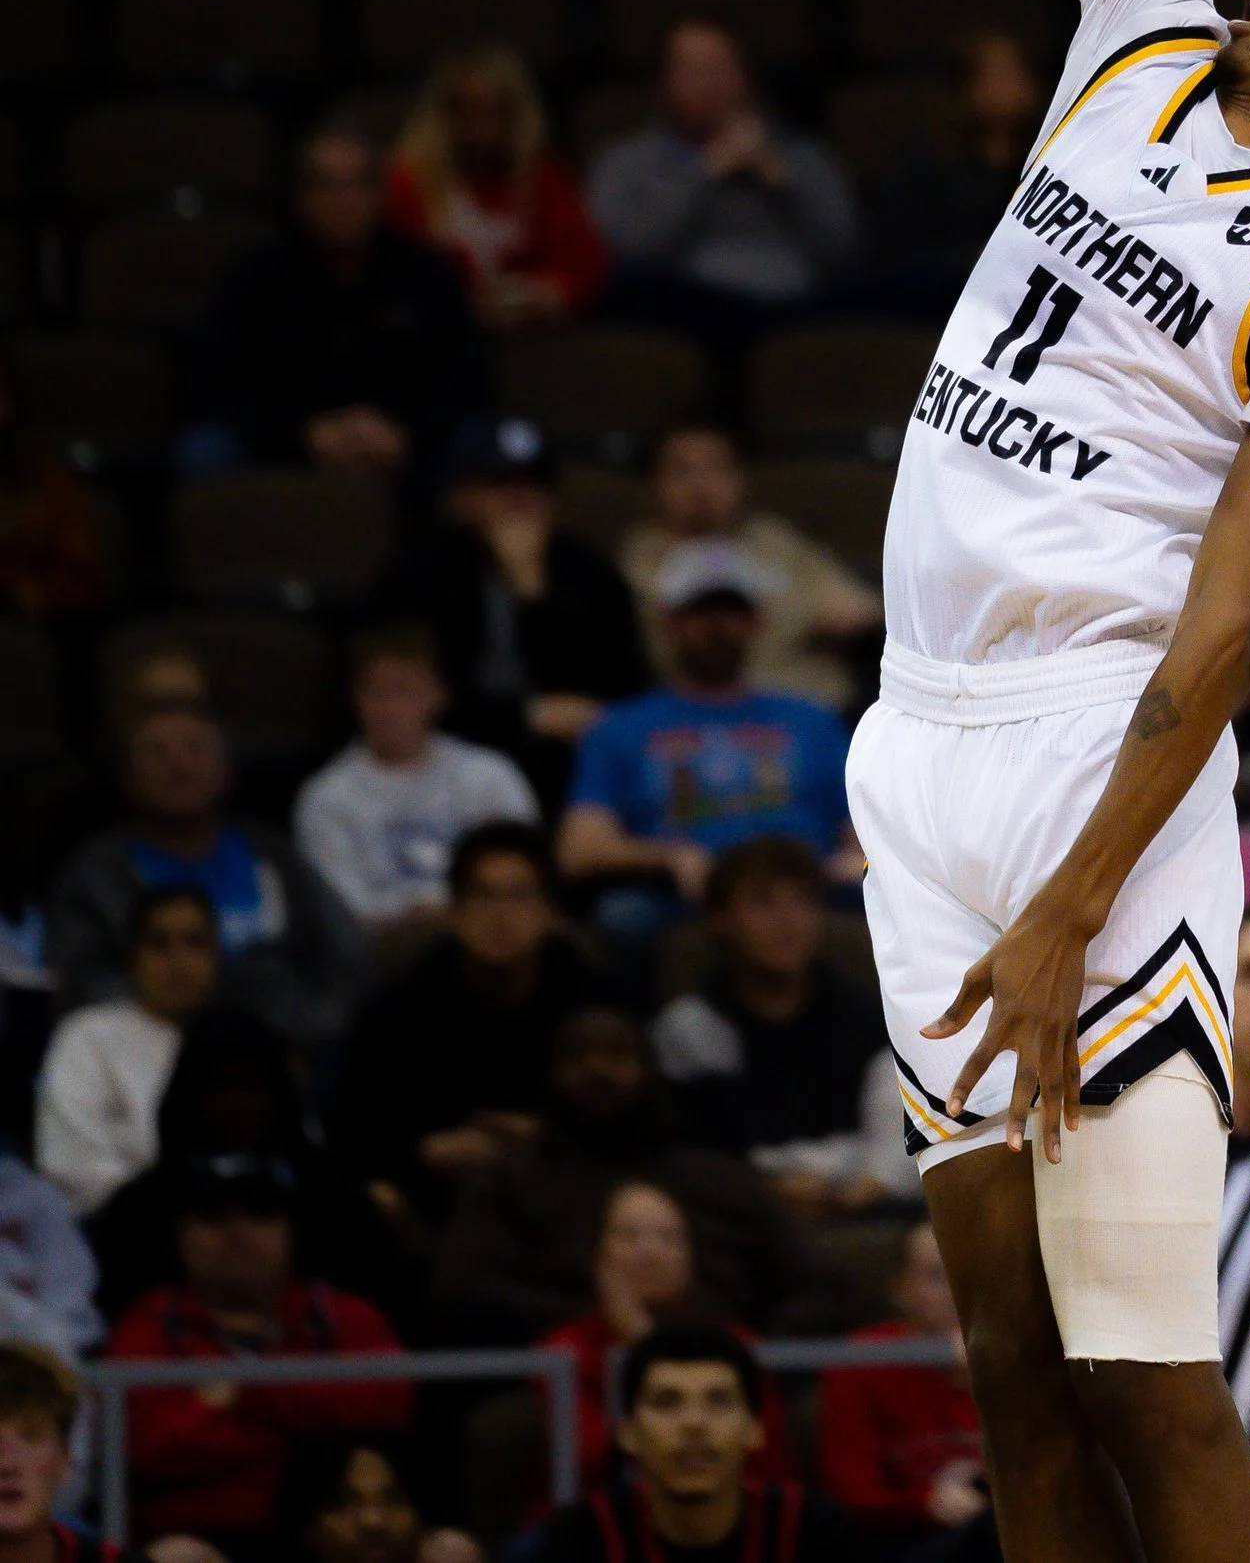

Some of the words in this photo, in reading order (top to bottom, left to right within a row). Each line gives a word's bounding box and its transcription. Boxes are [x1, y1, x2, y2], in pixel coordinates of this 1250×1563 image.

[1014, 165, 1213, 349] NORTHERN
[981, 264, 1085, 386] 11
[913, 361, 1112, 481] ENTUCKY
